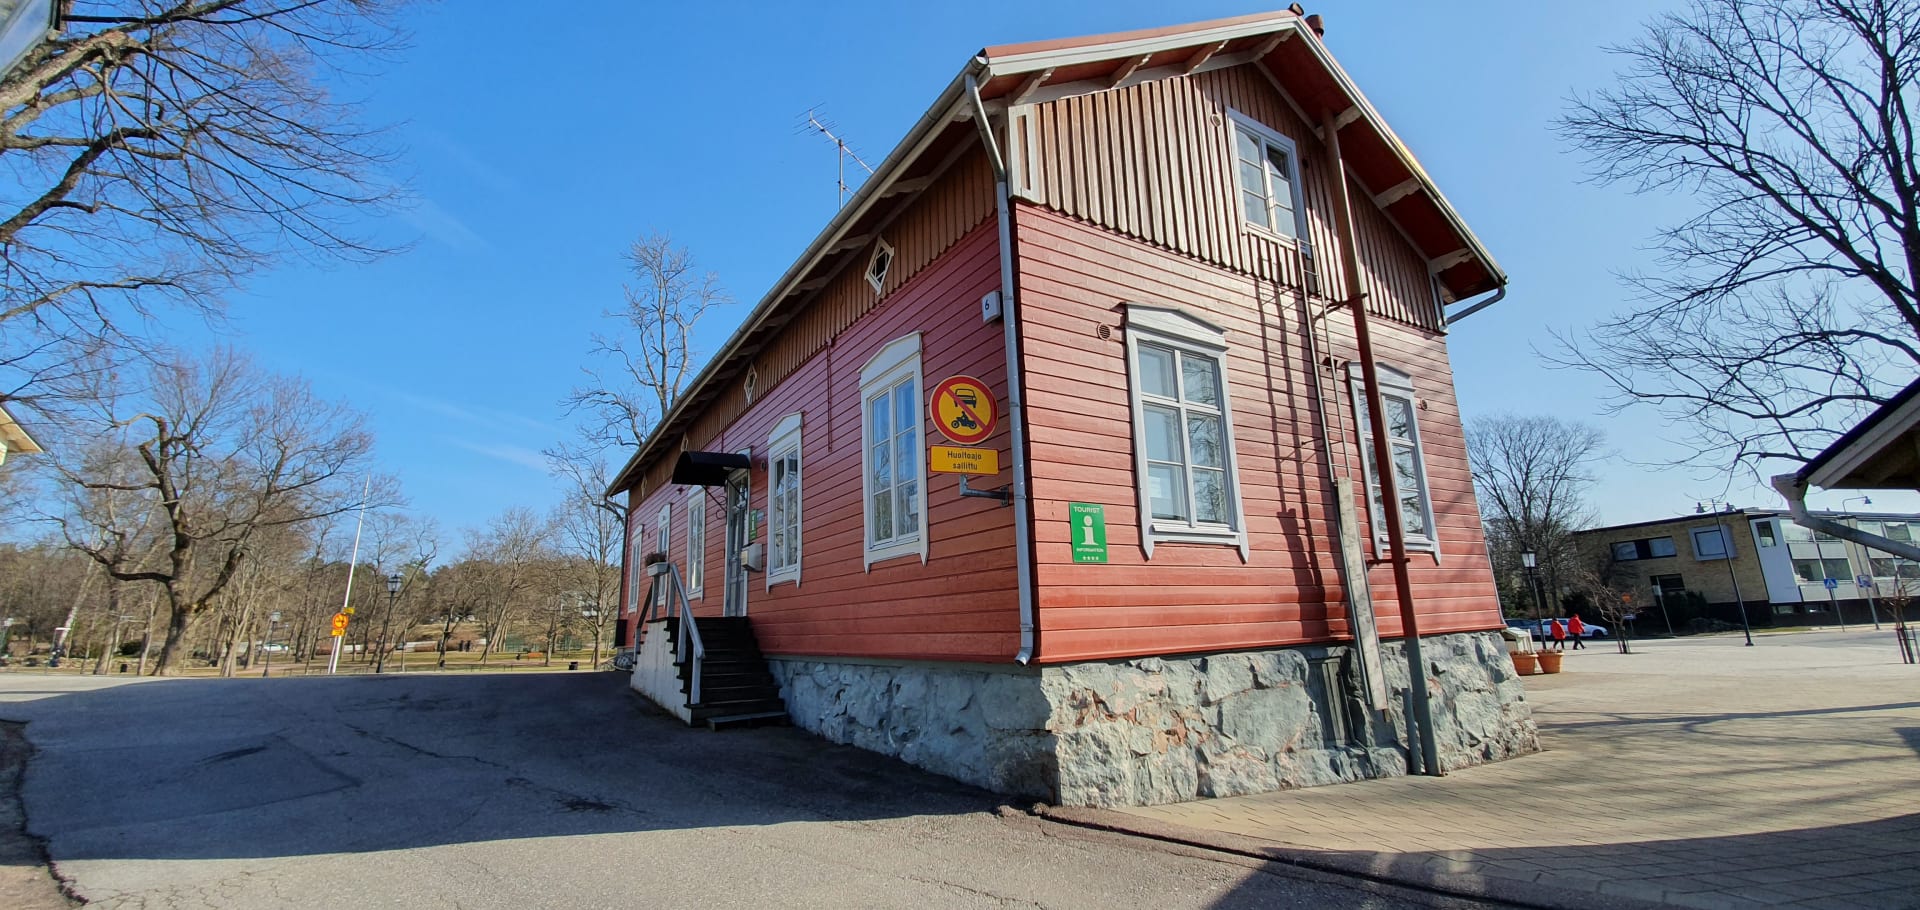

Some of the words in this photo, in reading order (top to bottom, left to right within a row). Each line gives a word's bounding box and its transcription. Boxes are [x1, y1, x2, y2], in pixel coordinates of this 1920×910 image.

[984, 299, 990, 310] 6
[947, 450, 982, 461] Huoltoajo
[952, 462, 978, 470] sallittu
